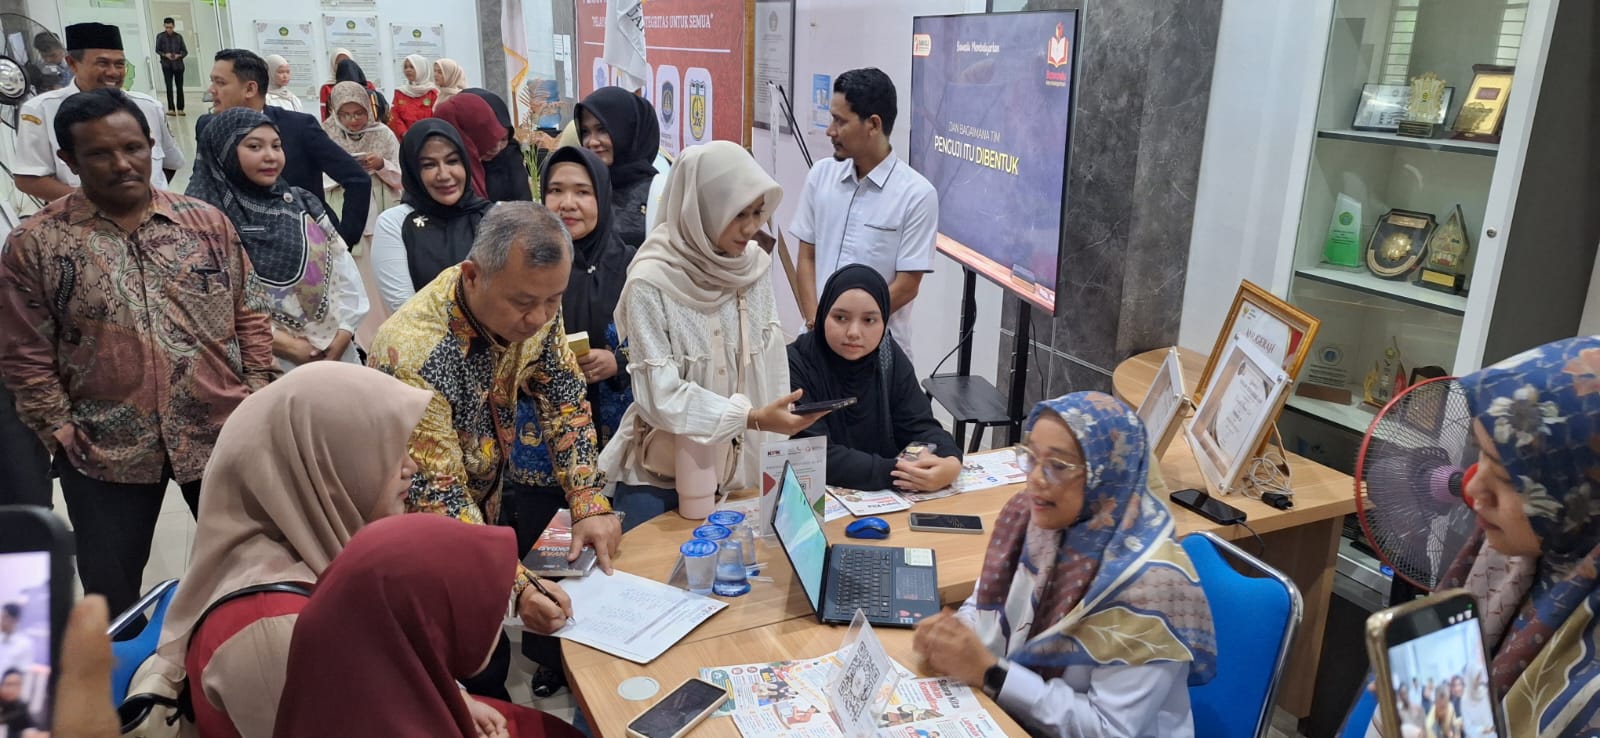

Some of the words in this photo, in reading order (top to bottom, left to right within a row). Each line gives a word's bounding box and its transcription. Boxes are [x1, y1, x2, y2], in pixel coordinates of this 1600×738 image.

[669, 15, 688, 29] UNTUK
[948, 121, 959, 132] DAN
[990, 130, 1001, 143] TIM
[934, 135, 962, 158] PENGUJI
[963, 143, 975, 162] ITU
[975, 146, 1020, 176] DIBENTUK
[948, 696, 960, 709] Kita
